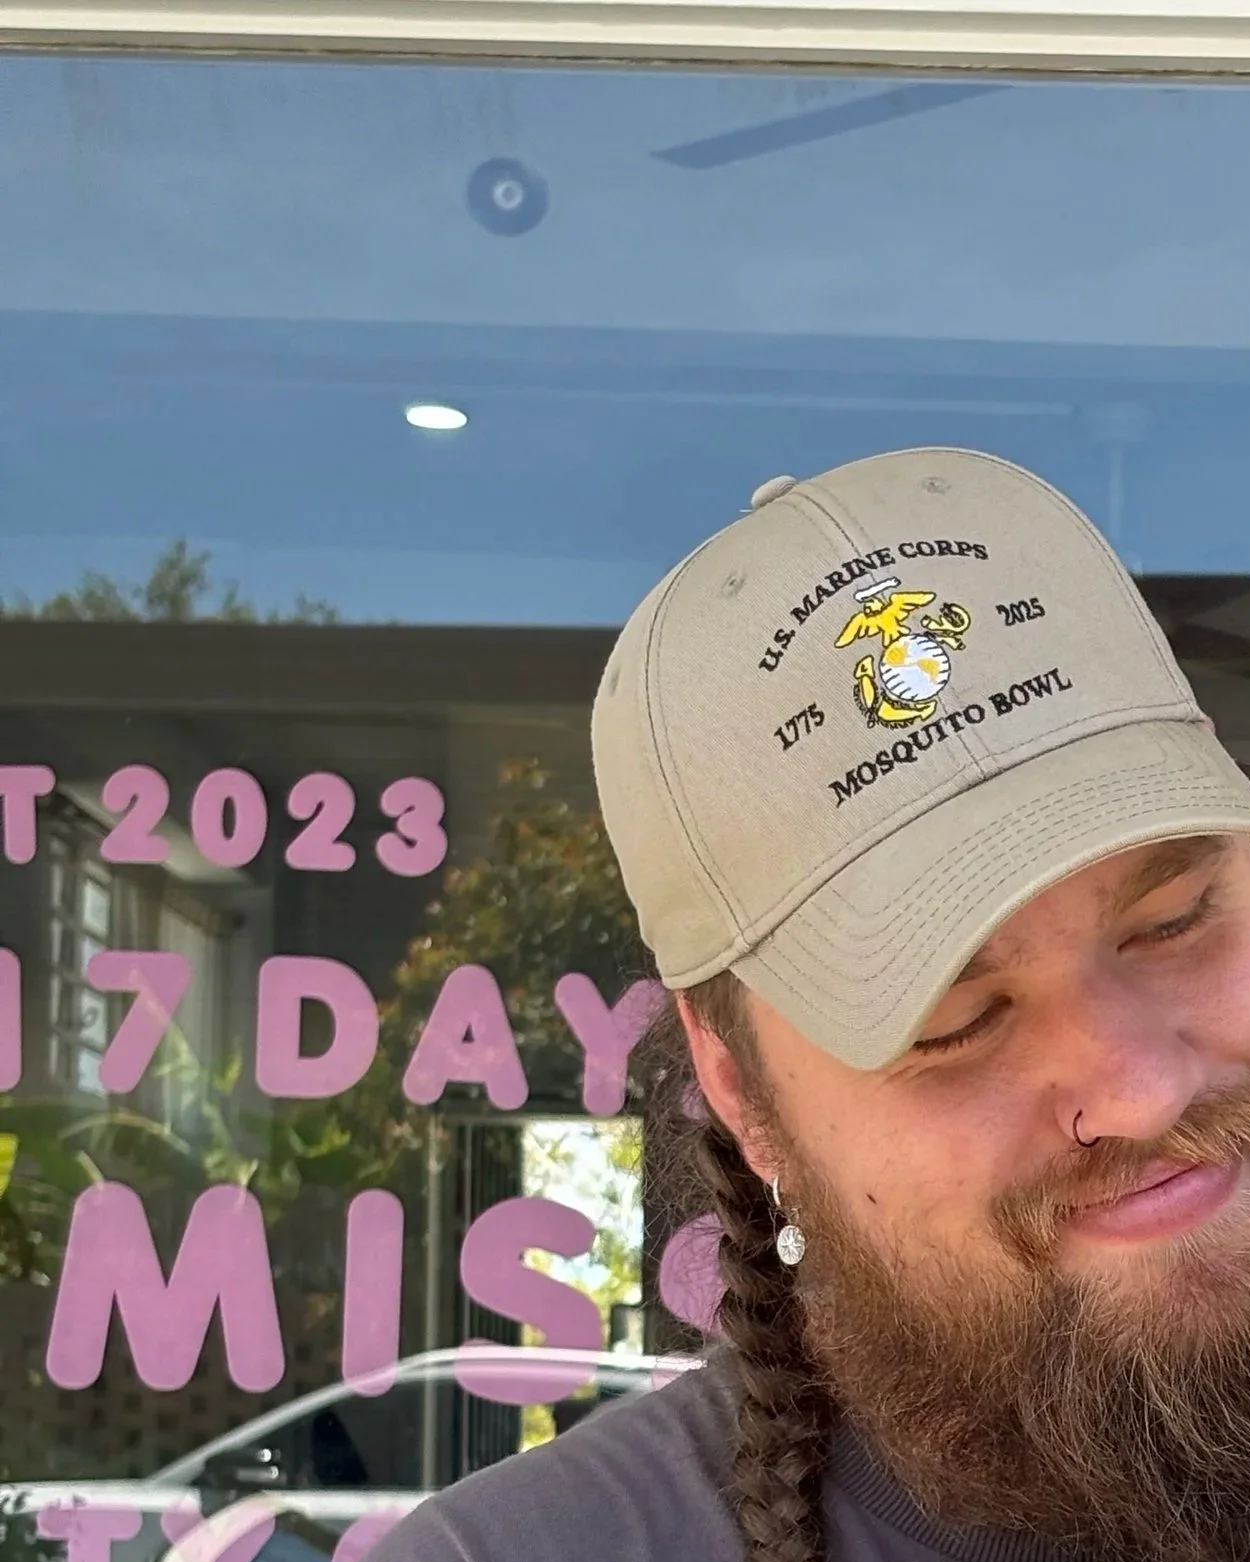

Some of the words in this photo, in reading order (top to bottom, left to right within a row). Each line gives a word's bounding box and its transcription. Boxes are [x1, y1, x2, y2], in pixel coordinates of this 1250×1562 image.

[759, 625, 797, 672] U.S.
[790, 546, 896, 623] MARINE
[898, 540, 989, 560] CORPS
[995, 597, 1046, 626] 2025
[773, 703, 826, 752] 1775
[827, 703, 986, 808] MOSQUITO
[988, 667, 1073, 716] BOWL
[100, 764, 448, 877] 2023
[255, 956, 706, 1120] DAY
